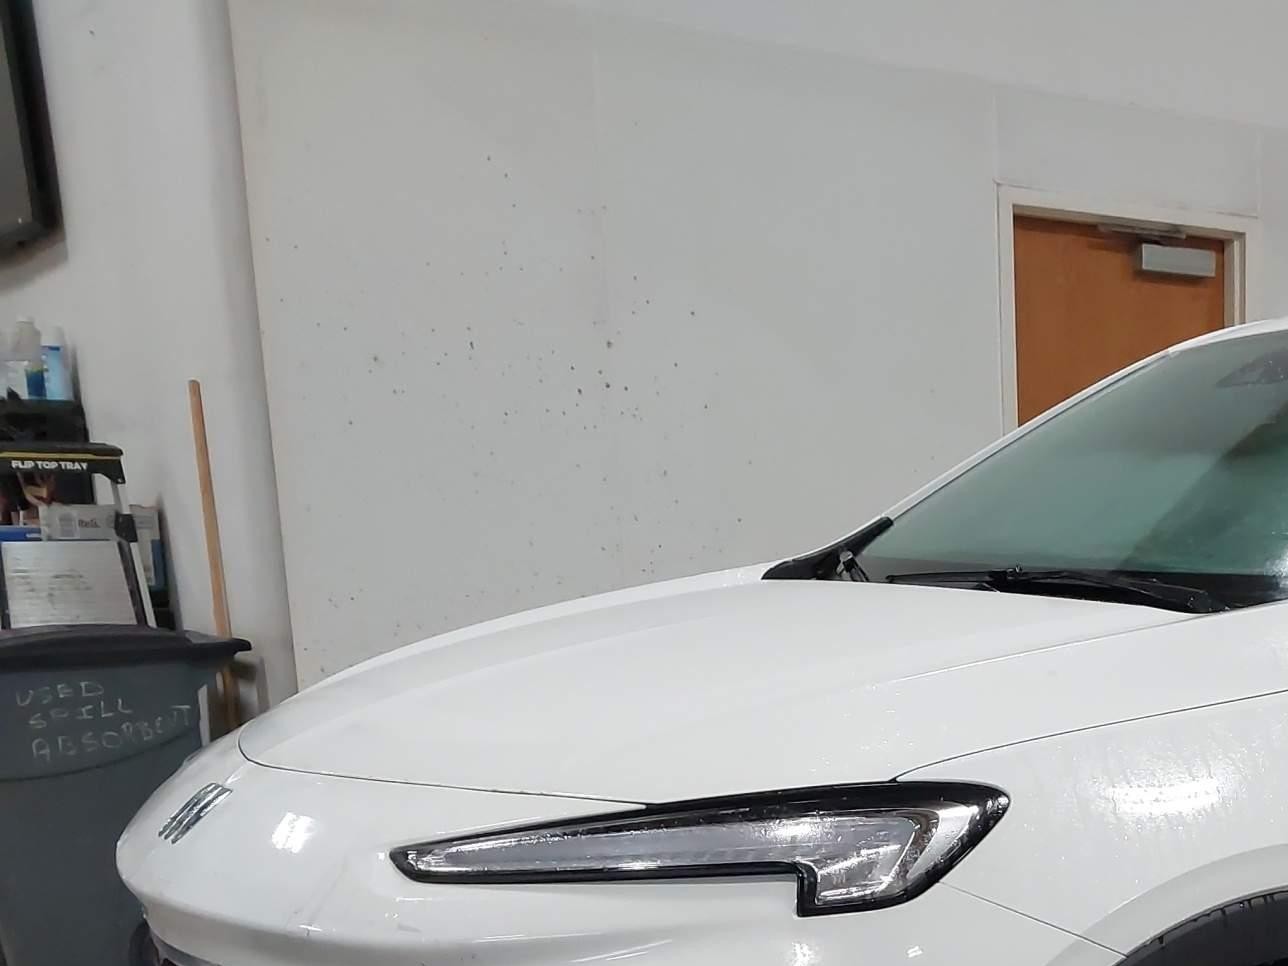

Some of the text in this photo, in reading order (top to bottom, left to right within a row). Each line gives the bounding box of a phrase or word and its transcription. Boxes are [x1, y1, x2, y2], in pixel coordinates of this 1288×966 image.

[11, 460, 88, 471] FLIP TOP TRAY
[16, 681, 104, 707] USED
[28, 698, 133, 729] SPILL
